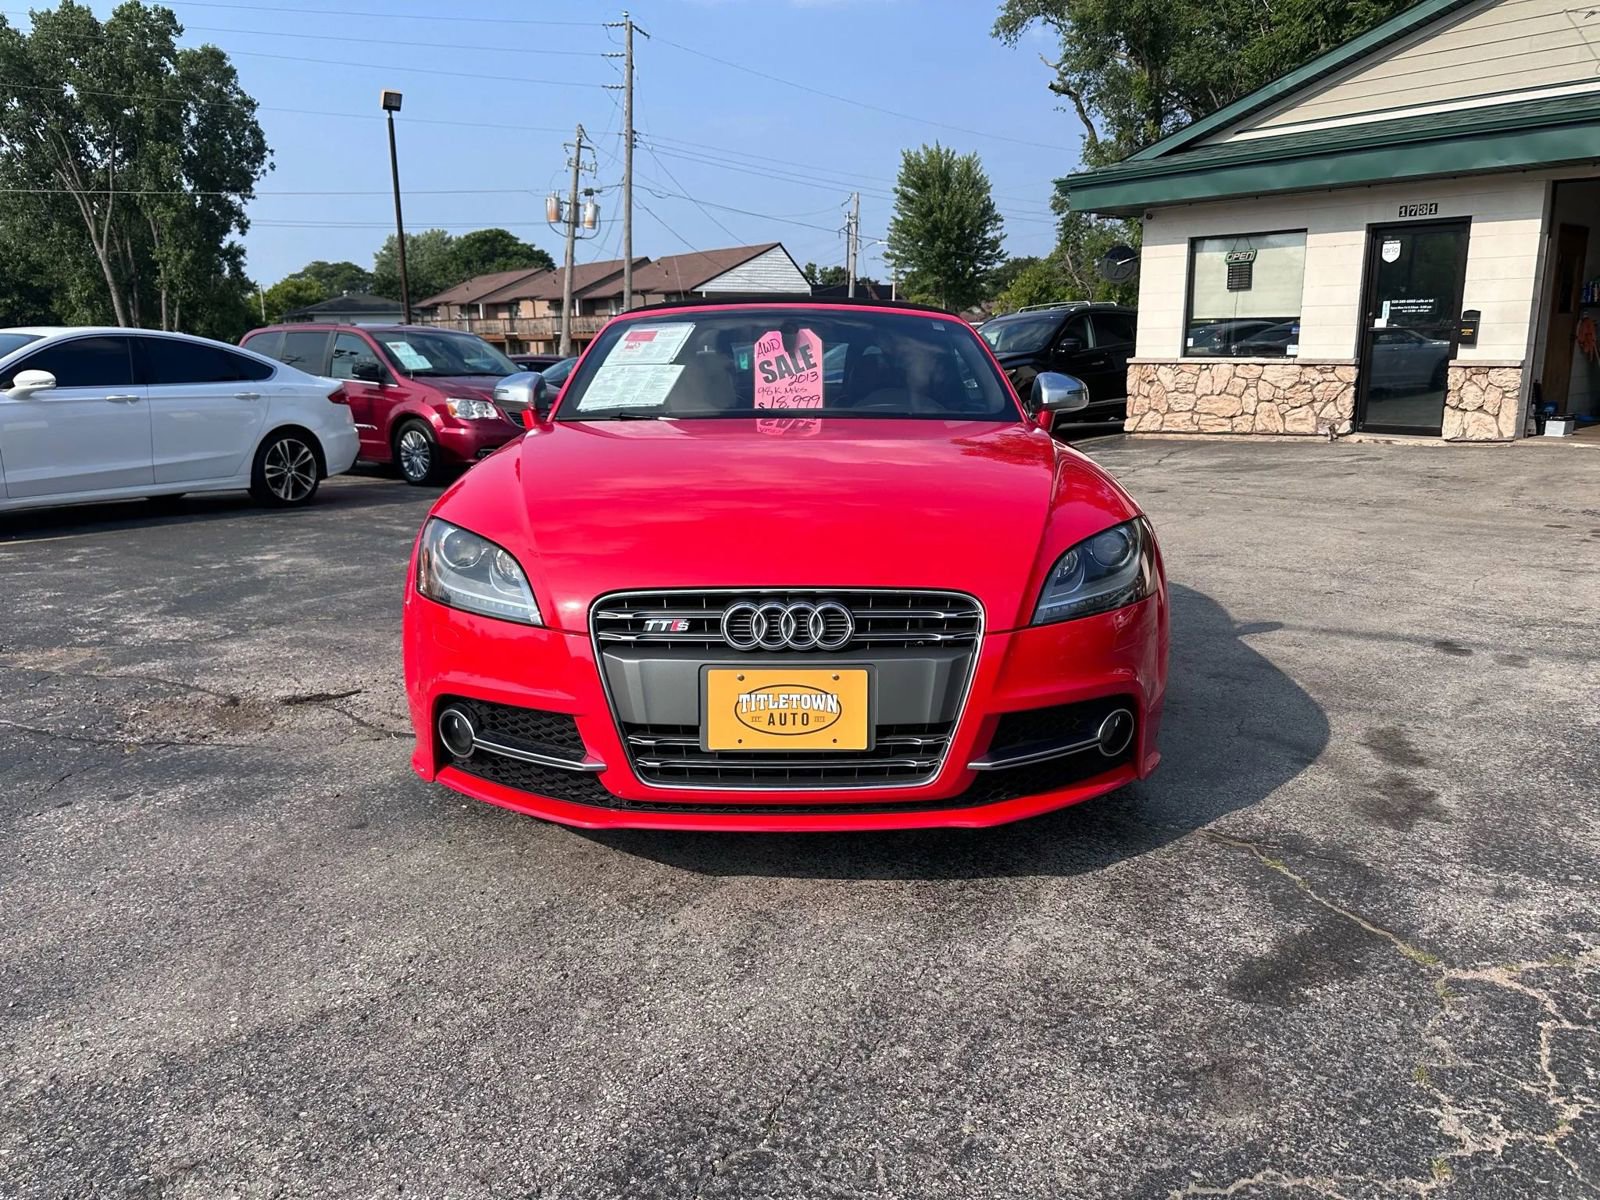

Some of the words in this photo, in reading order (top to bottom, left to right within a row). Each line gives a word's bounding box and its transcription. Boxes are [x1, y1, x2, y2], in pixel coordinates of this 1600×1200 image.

[1398, 202, 1439, 218] 1731
[1226, 250, 1255, 262] OPEN
[757, 338, 781, 358] AWD
[758, 344, 818, 384] SALE
[788, 371, 819, 387] 2013
[738, 692, 839, 714] TITLETOWN
[767, 712, 810, 726] AUTO
